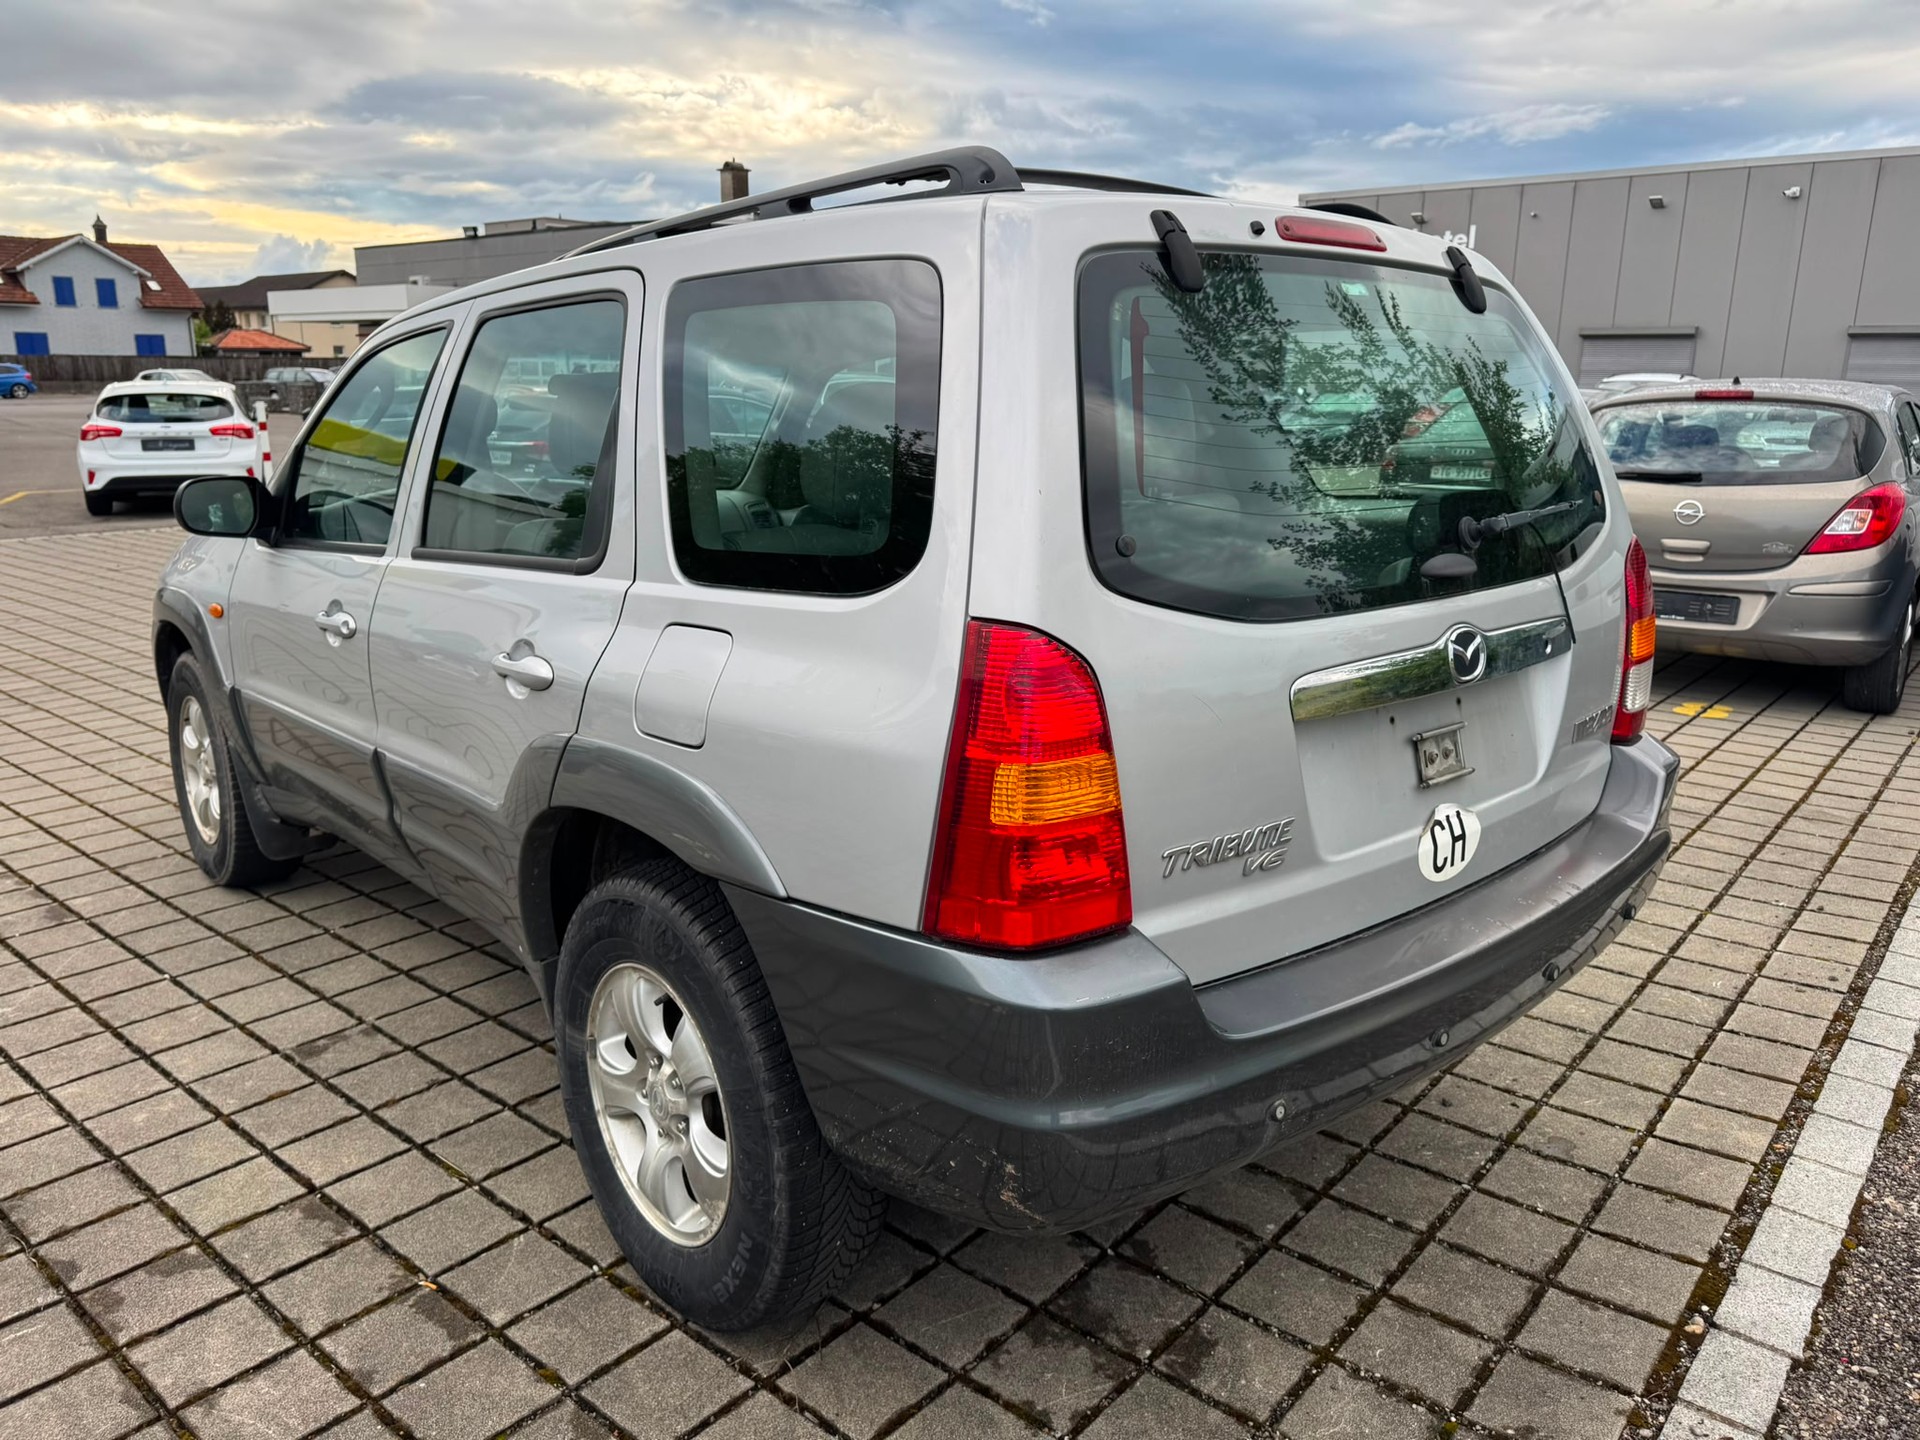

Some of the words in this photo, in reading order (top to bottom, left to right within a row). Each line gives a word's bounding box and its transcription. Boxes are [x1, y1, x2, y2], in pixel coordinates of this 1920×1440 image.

[1162, 816, 1295, 878] TRIBUTE
[1242, 848, 1288, 877] V6
[1430, 810, 1466, 873] CH
